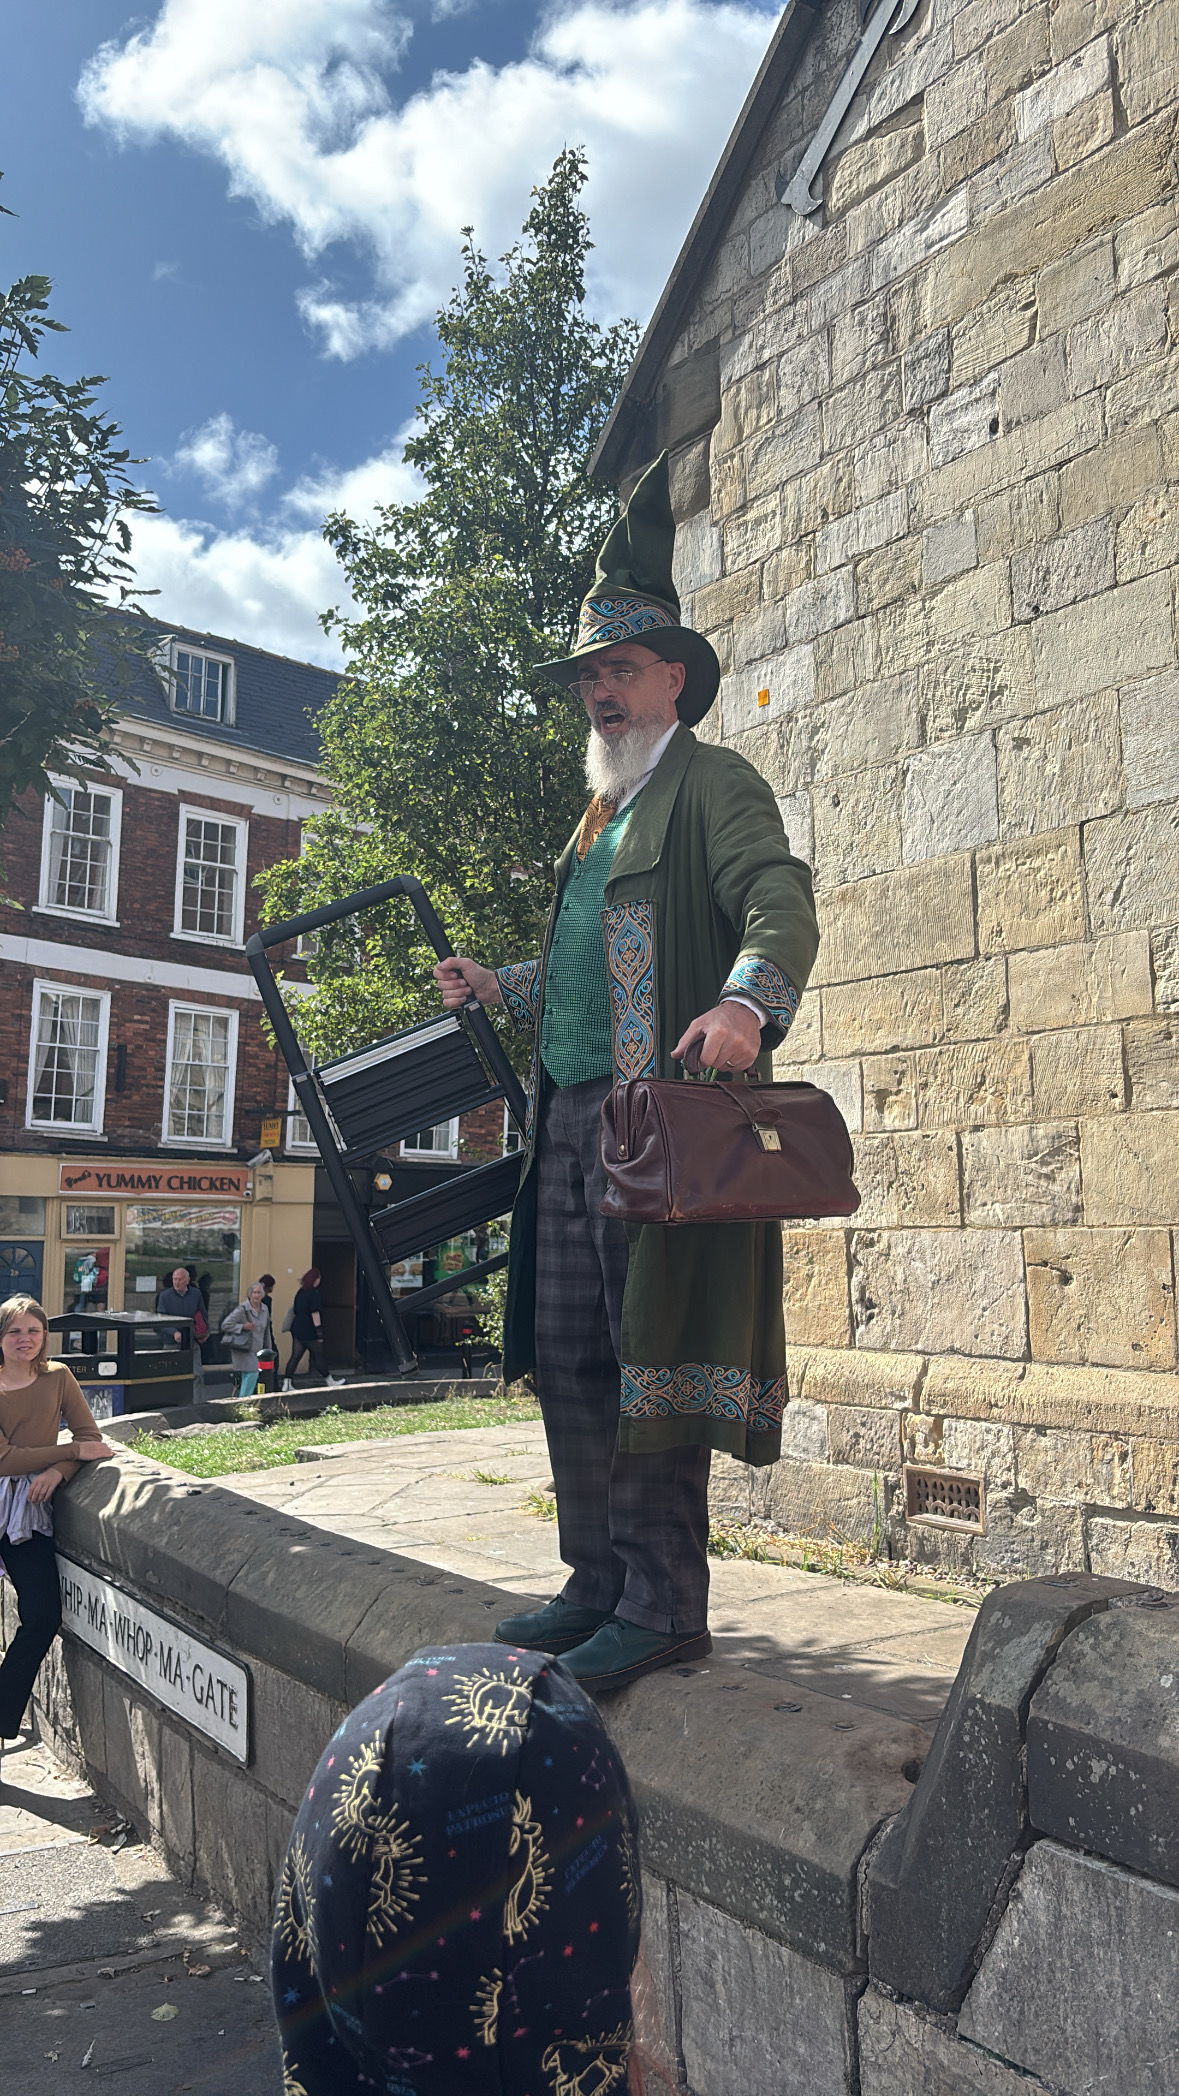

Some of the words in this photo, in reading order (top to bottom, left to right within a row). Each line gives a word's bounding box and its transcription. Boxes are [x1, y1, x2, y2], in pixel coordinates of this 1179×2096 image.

[95, 1173, 164, 1190] YUMMY
[167, 1175, 240, 1191] CHICKEN
[70, 1365, 87, 1373] TER
